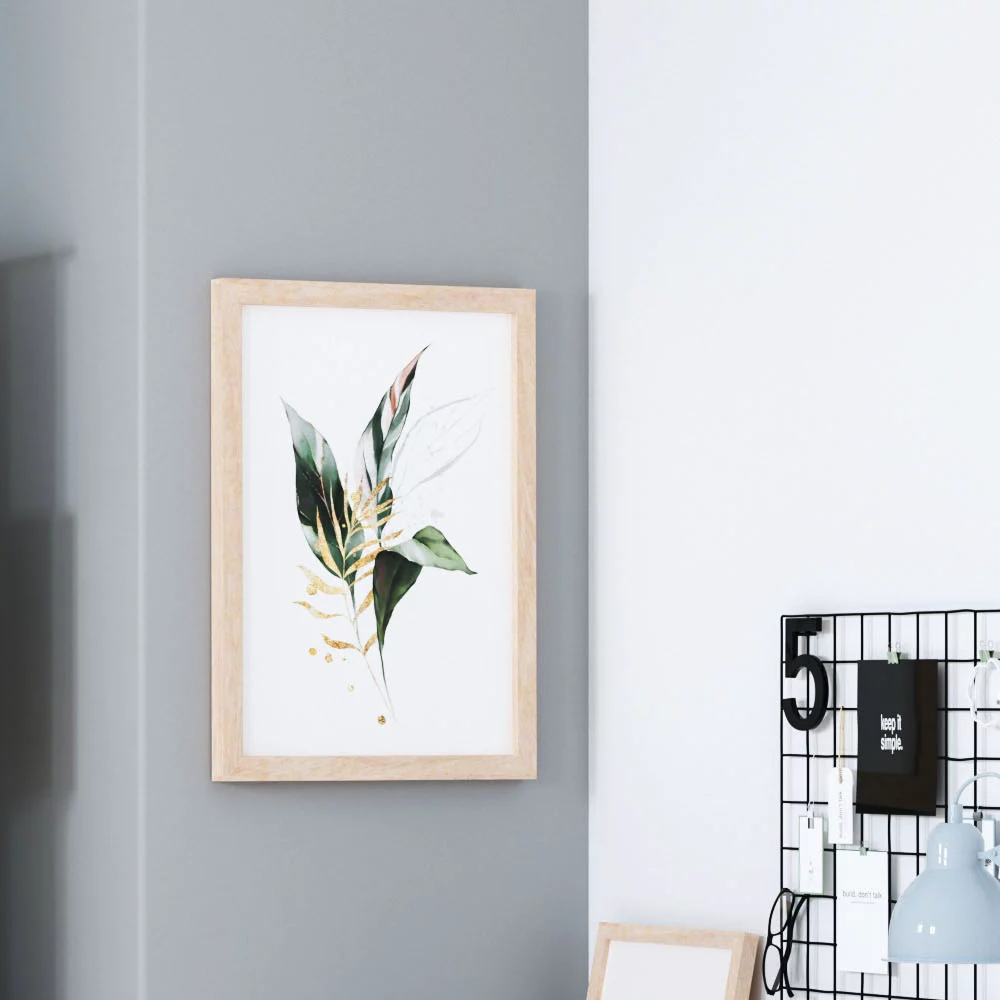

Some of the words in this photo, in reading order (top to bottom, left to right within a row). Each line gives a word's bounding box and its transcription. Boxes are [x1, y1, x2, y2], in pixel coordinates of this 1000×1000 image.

[782, 618, 828, 731] 5
[880, 714, 896, 734] keep
[896, 714, 902, 731] it
[880, 734, 903, 754] simple.
